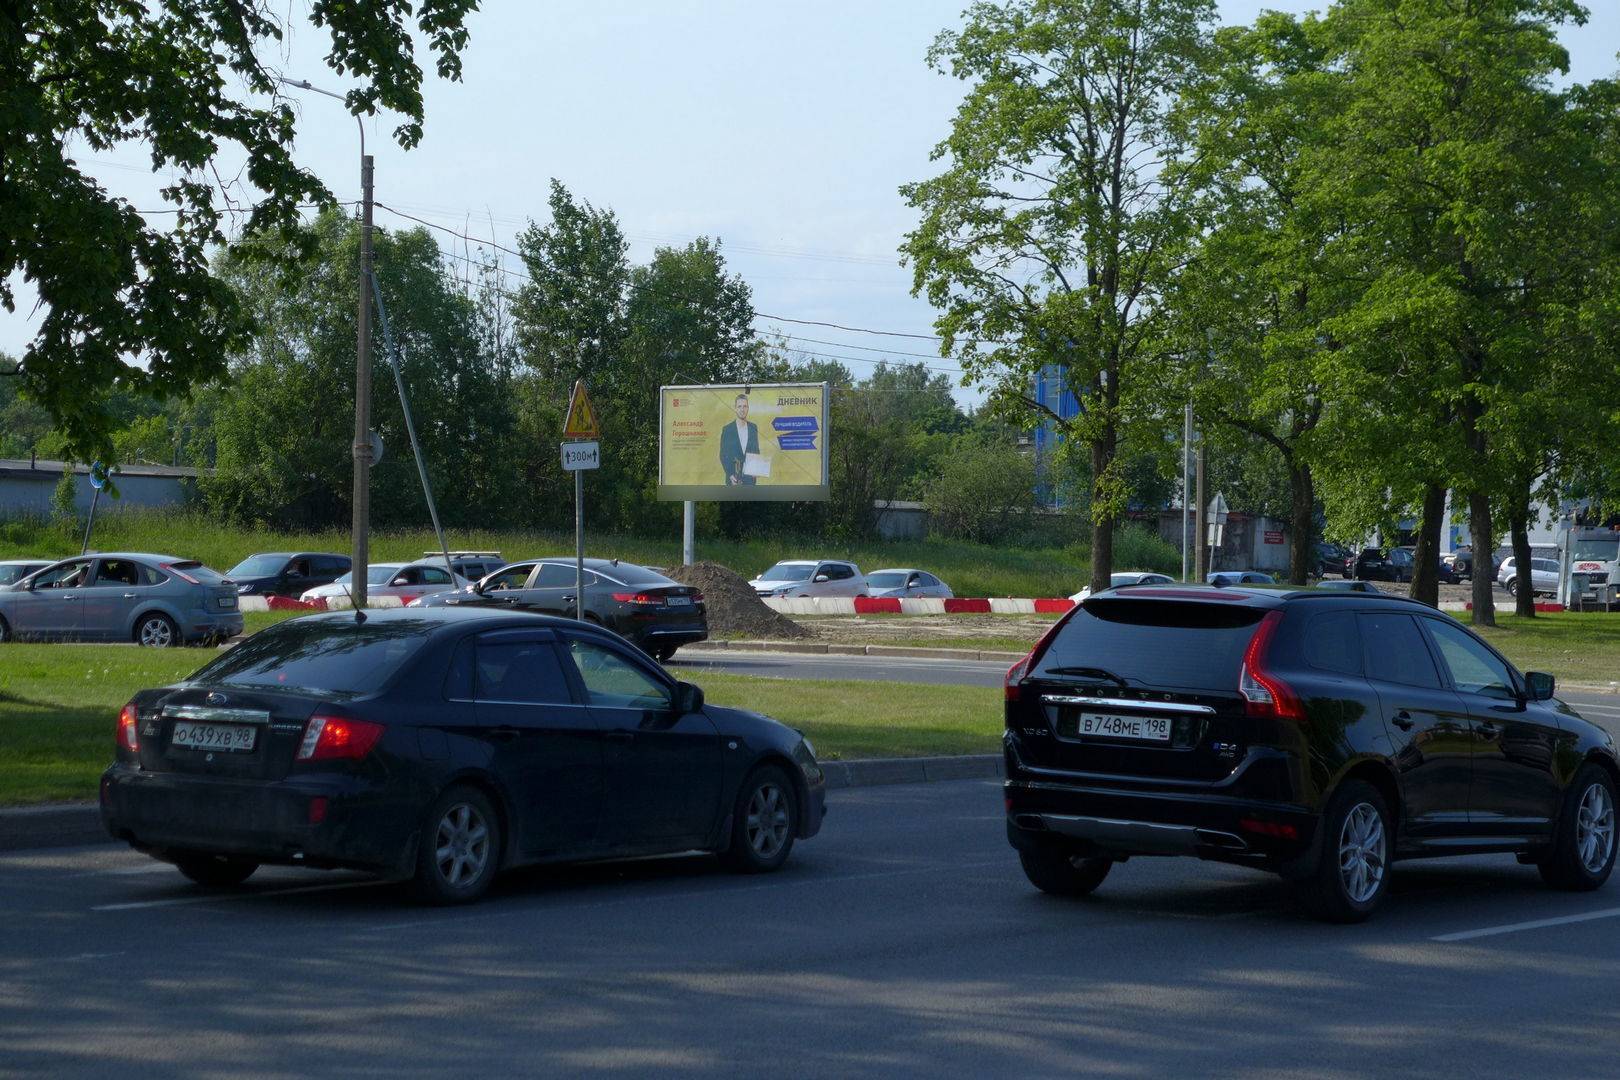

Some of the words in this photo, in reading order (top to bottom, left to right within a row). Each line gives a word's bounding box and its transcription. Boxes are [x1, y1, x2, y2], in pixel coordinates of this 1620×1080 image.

[777, 397, 817, 406] ДНЕВНИК
[1074, 687, 1171, 701] VOLVO
[1084, 716, 1140, 736] В748МЕ
[1144, 719, 1166, 733] 198
[178, 726, 232, 745] О439ХВ
[236, 728, 250, 742] 98
